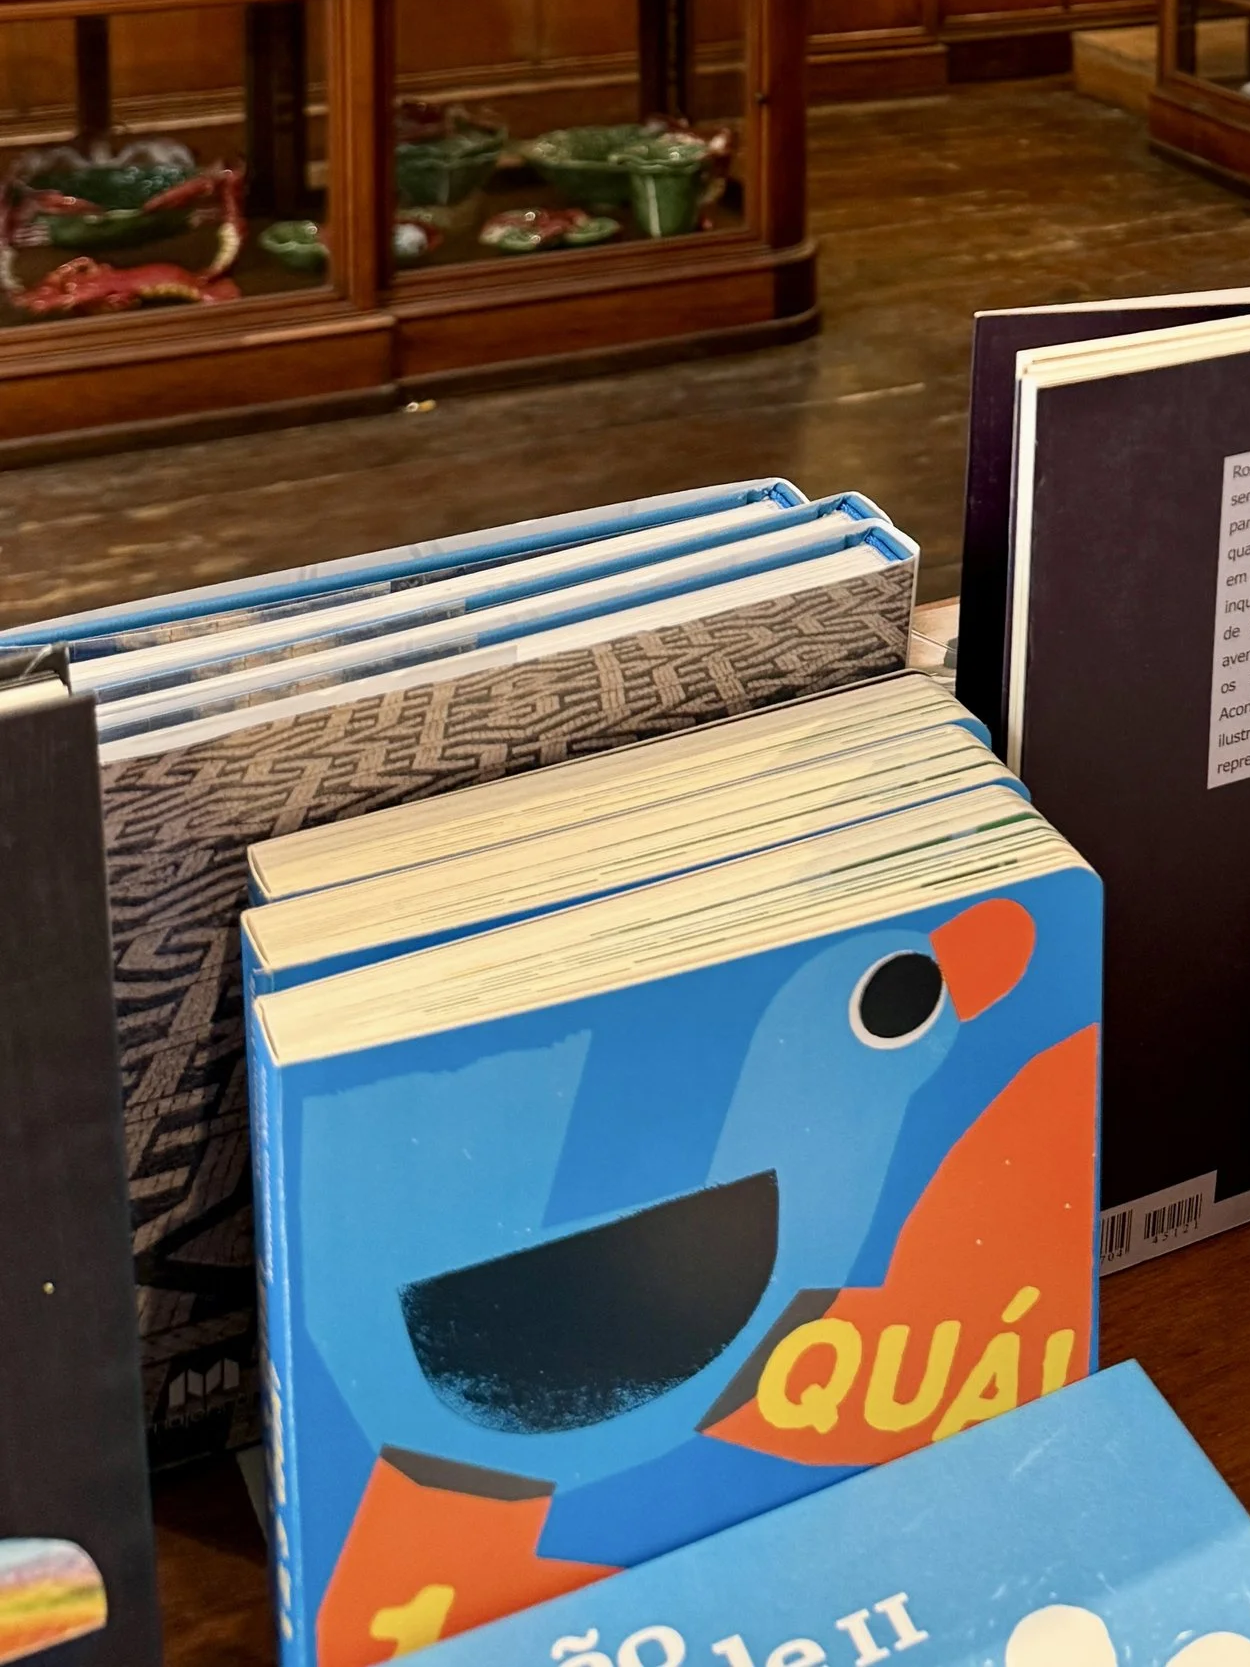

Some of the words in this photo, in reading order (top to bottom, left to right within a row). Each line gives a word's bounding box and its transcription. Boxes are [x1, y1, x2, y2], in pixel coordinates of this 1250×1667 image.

[1225, 572, 1247, 587] em
[1223, 625, 1241, 641] de
[1220, 679, 1236, 694] os
